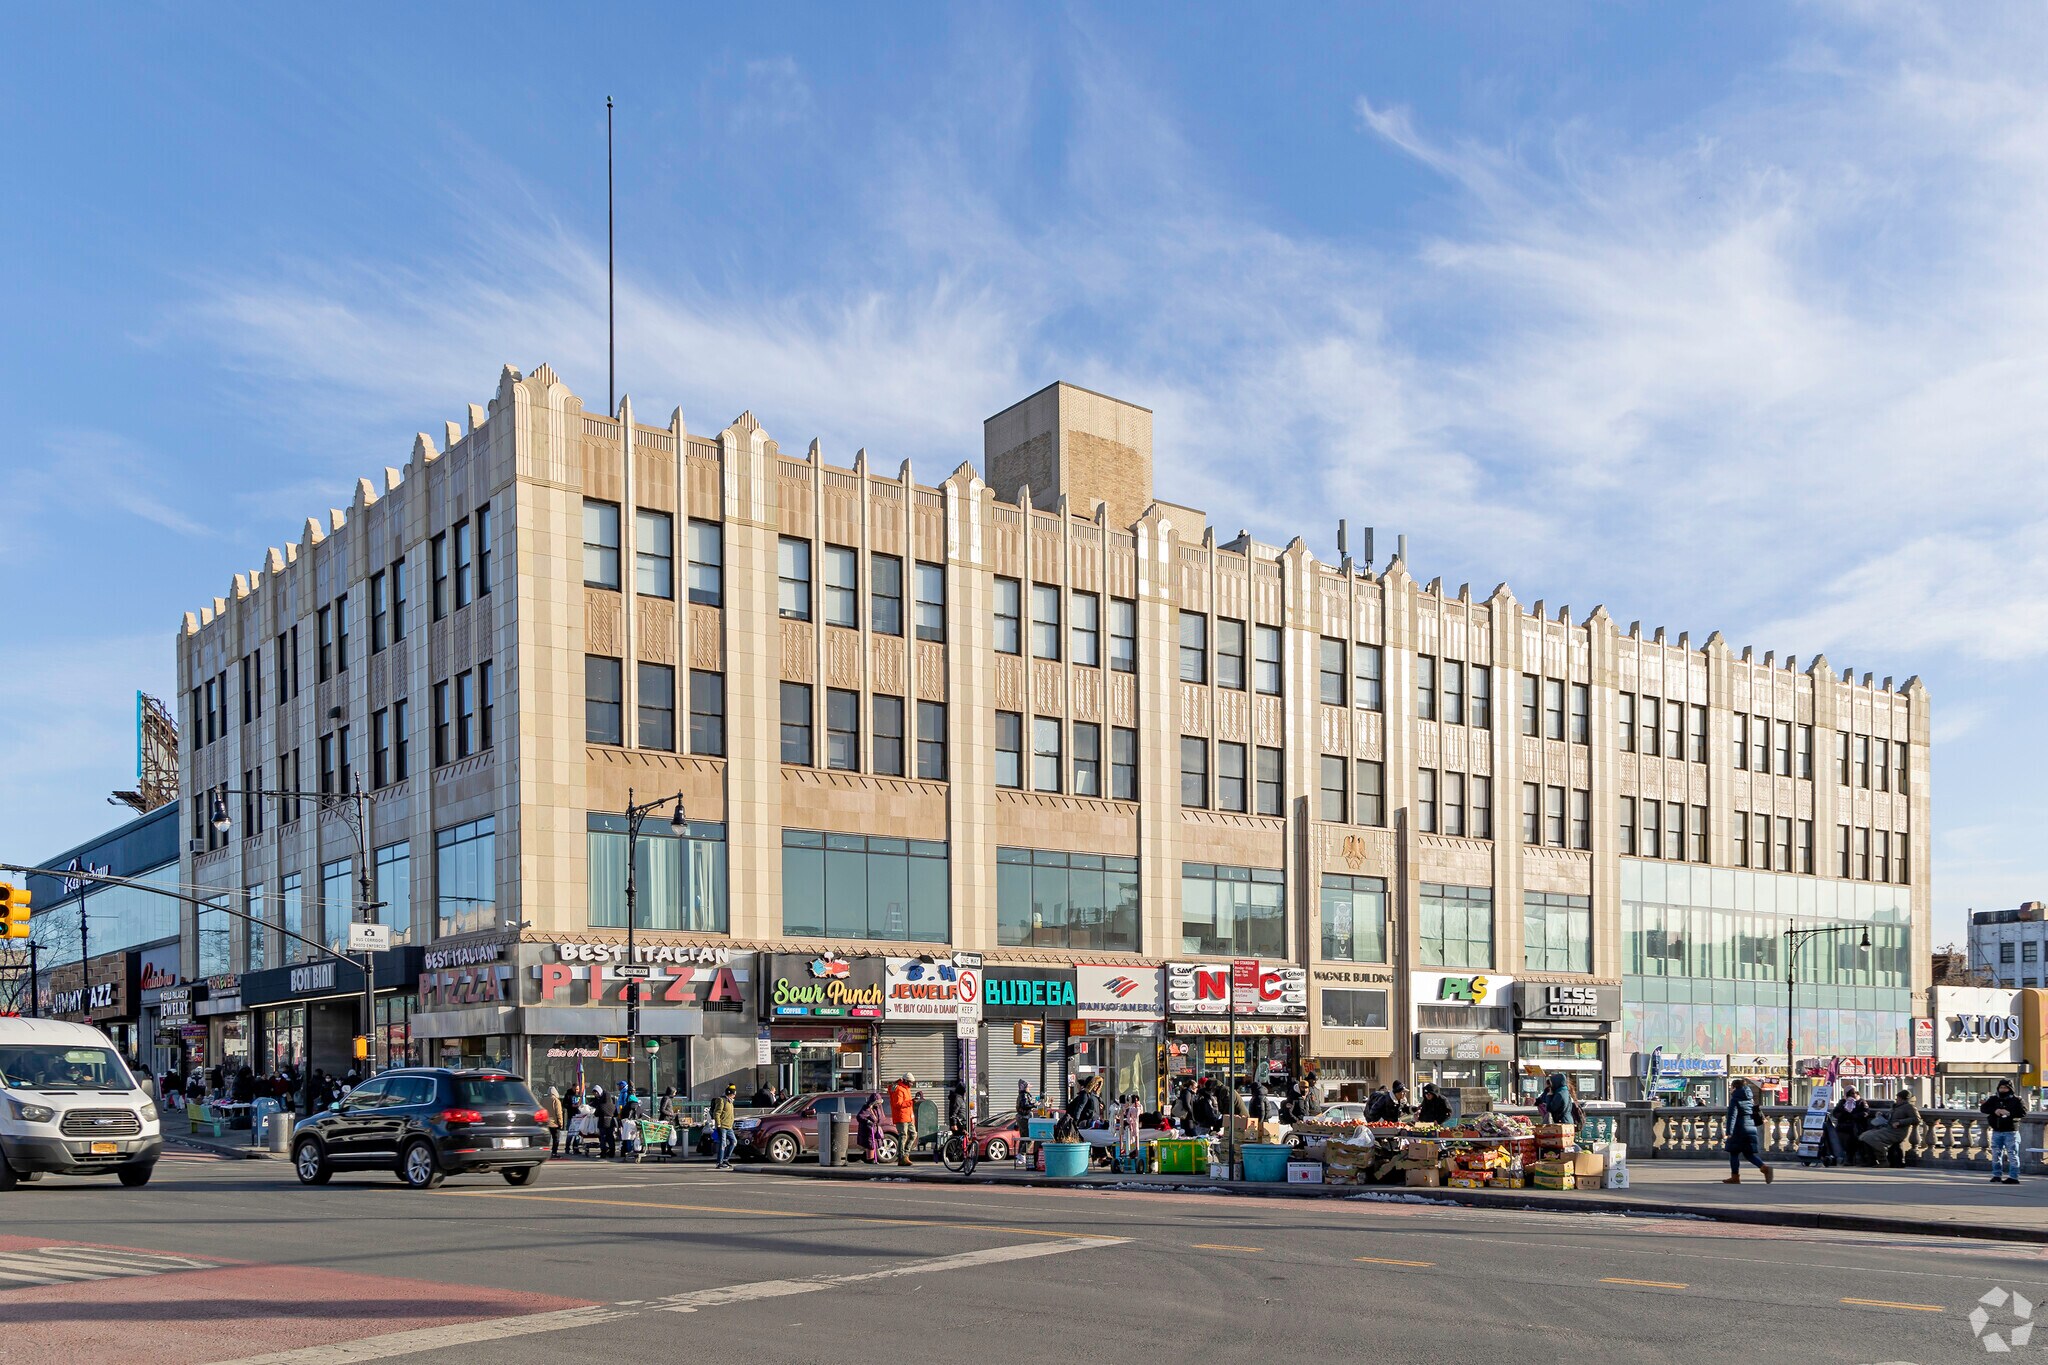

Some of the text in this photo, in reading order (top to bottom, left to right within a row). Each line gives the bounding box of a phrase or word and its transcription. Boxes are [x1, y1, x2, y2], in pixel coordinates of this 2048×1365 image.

[64, 857, 110, 894] Ranbow
[425, 944, 496, 969] BEST ITALIAN
[560, 943, 729, 964] BEST ITALIAN
[141, 961, 175, 990] Rainbow
[419, 964, 500, 1006] PIZZA
[1313, 971, 1394, 984] WAGNER BUILDING
[774, 978, 884, 1006] Sour Punch
[889, 983, 958, 1000] JEWELR
[985, 978, 1076, 1006] BUDEGA
[1199, 970, 1283, 1001] NC
[53, 988, 83, 1014] JIMMY
[1550, 986, 1598, 1005] LESS
[160, 1000, 188, 1019] JEWELRY
[894, 1003, 902, 1013] WE
[903, 1003, 915, 1013] BUY
[916, 1004, 933, 1014] GOLD
[934, 1005, 939, 1014] &
[1079, 1002, 1164, 1012] BANK OF AMERICA
[1550, 1004, 1598, 1017] CLOTHING
[1957, 1013, 2020, 1041] XIOS
[1423, 1047, 1449, 1055] CASHING
[1426, 1038, 1445, 1046] CHECK
[1457, 1043, 1479, 1051] MONEY
[1485, 1041, 1501, 1055] ria
[1456, 1051, 1480, 1059] ORDERS
[1663, 1058, 1722, 1070] PHARMACY
[1866, 1057, 1936, 1076] FURNITURE
